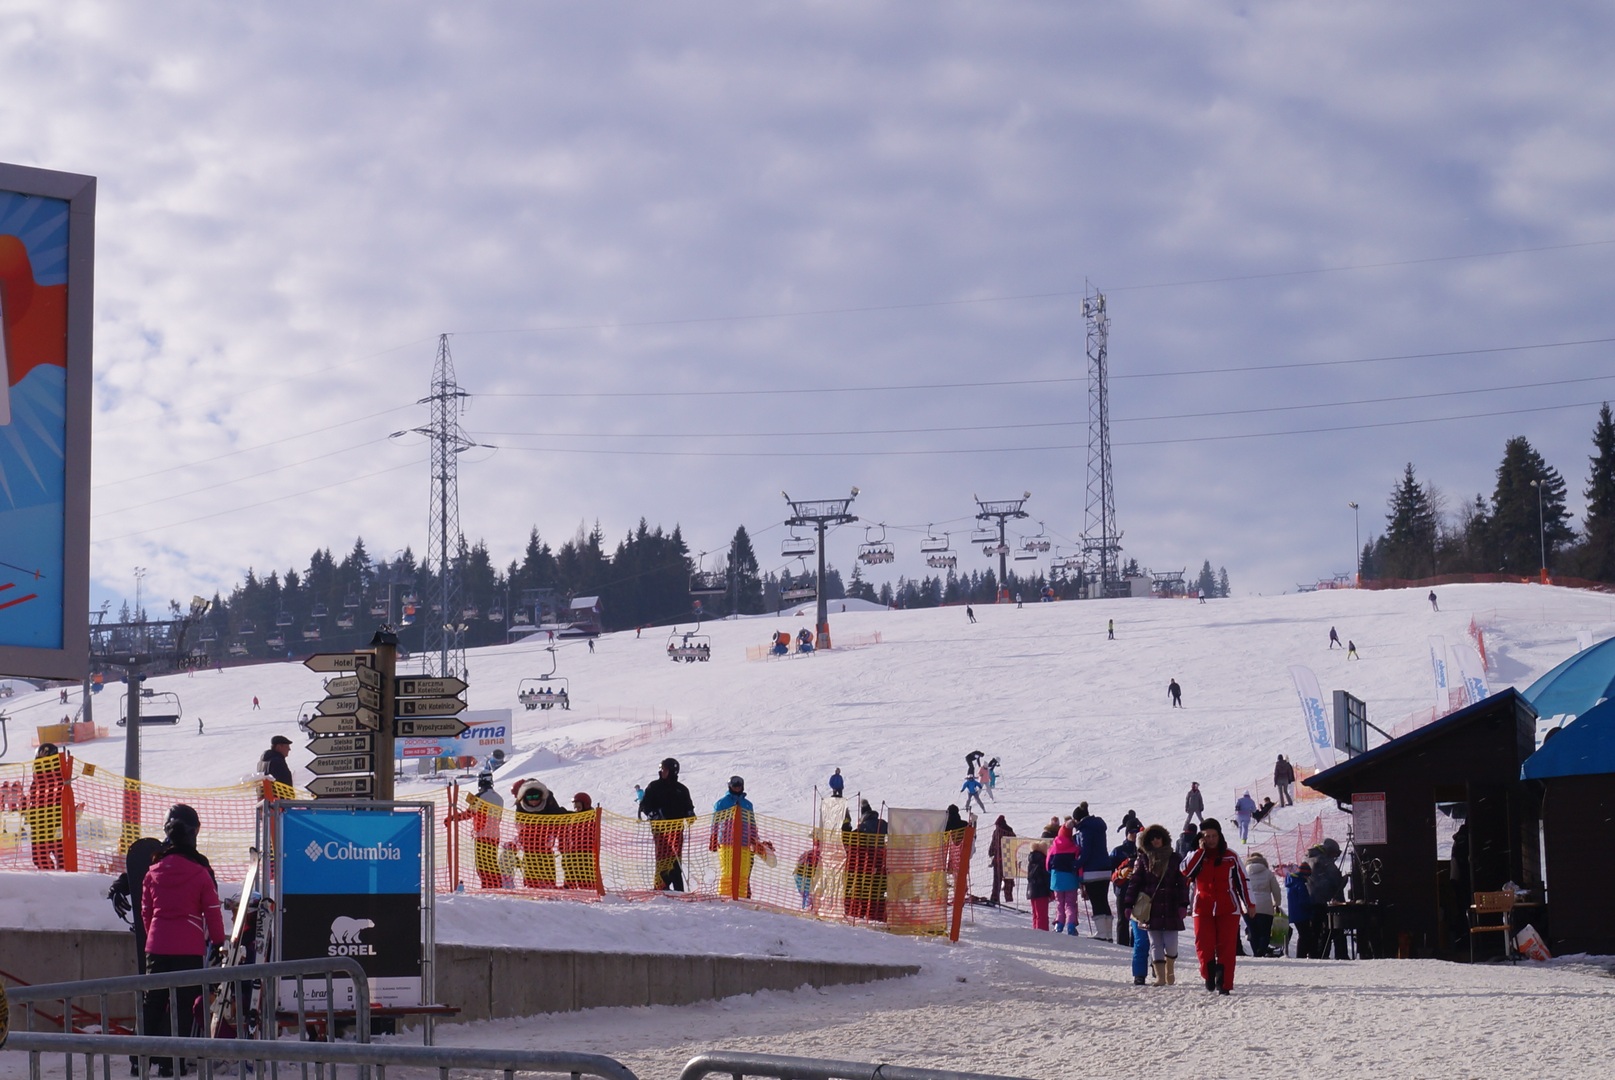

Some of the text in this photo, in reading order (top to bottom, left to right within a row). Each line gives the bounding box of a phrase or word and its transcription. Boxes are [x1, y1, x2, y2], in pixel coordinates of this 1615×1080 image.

[334, 659, 353, 667] Hotel
[336, 701, 356, 710] Sklepy
[460, 726, 506, 739] erma
[317, 758, 352, 766] Restauracja
[324, 841, 401, 861] Columbia
[328, 944, 377, 956] SOREL
